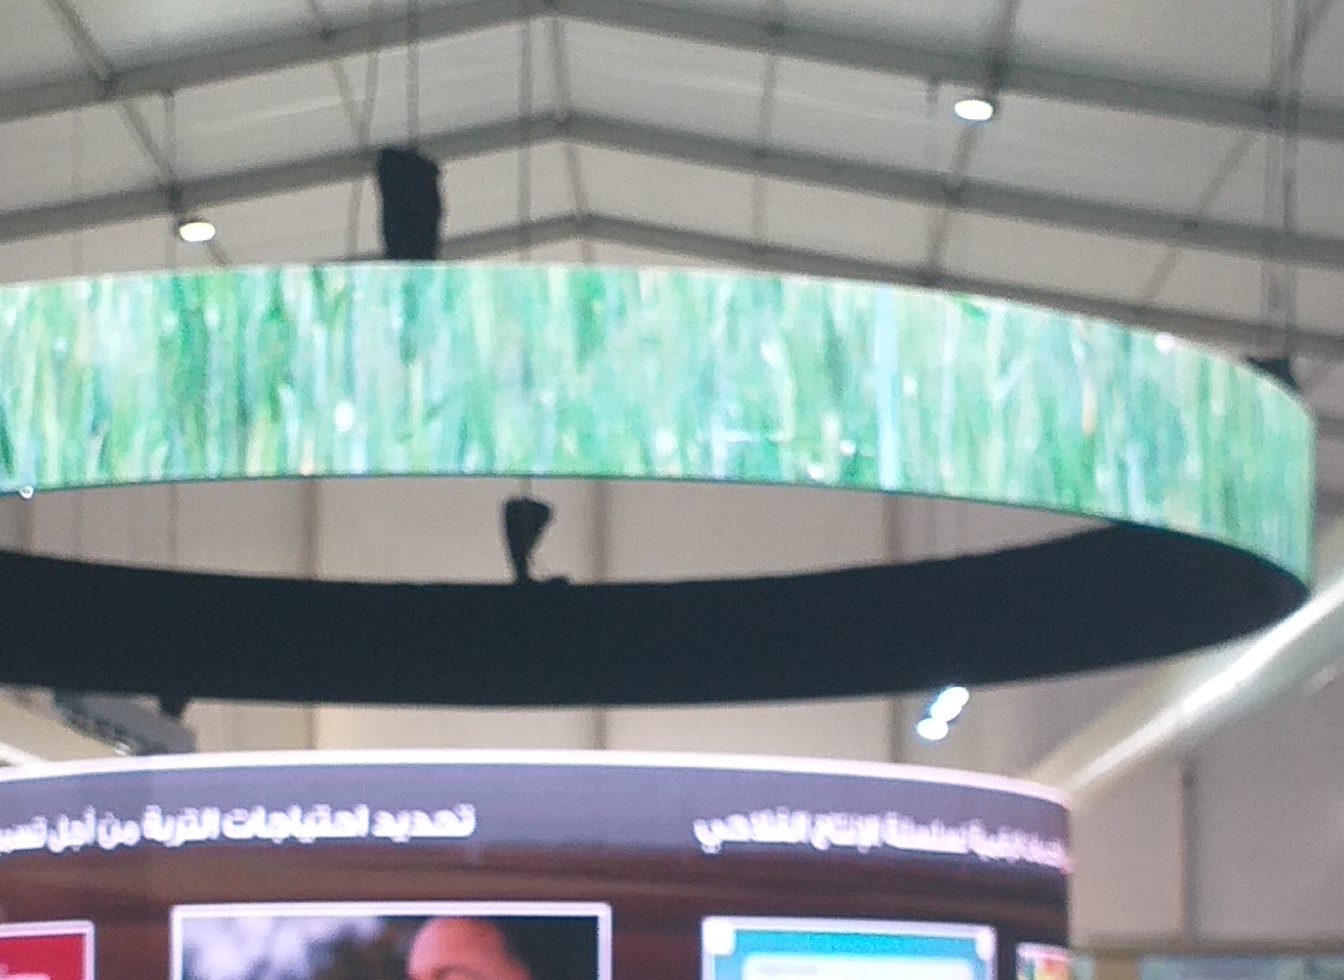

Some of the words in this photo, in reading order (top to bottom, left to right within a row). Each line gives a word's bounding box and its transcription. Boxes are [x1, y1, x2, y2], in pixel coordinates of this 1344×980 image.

[47, 804, 96, 853] أجل
[97, 811, 141, 850] من
[142, 804, 221, 847] التربة
[221, 803, 370, 844] احتياجات
[370, 802, 477, 843] تحديد
[691, 805, 811, 854] الفلاحي
